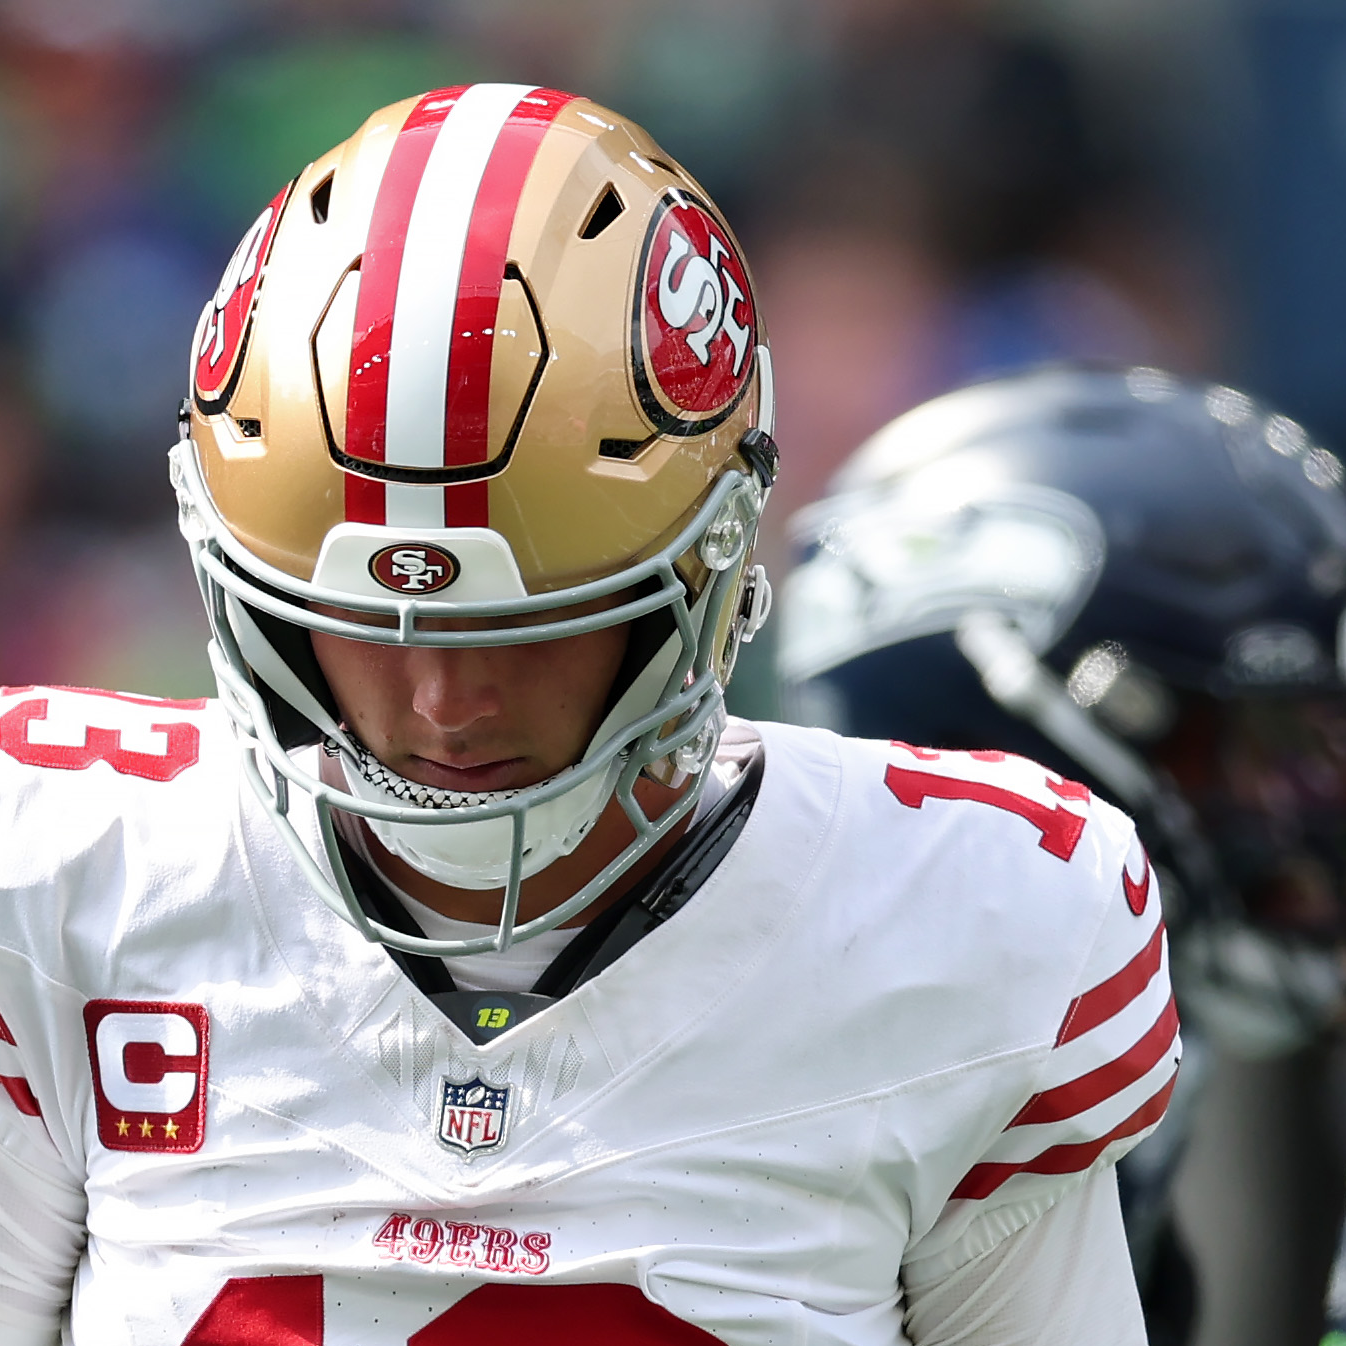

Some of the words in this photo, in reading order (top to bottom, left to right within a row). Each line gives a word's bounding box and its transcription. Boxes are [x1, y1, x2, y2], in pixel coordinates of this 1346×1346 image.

[658, 229, 750, 378] SF
[391, 549, 443, 589] SF
[476, 1008, 510, 1028] 13
[96, 1012, 198, 1114] C
[445, 1109, 497, 1144] NFL
[372, 1212, 551, 1275] 49ERS
